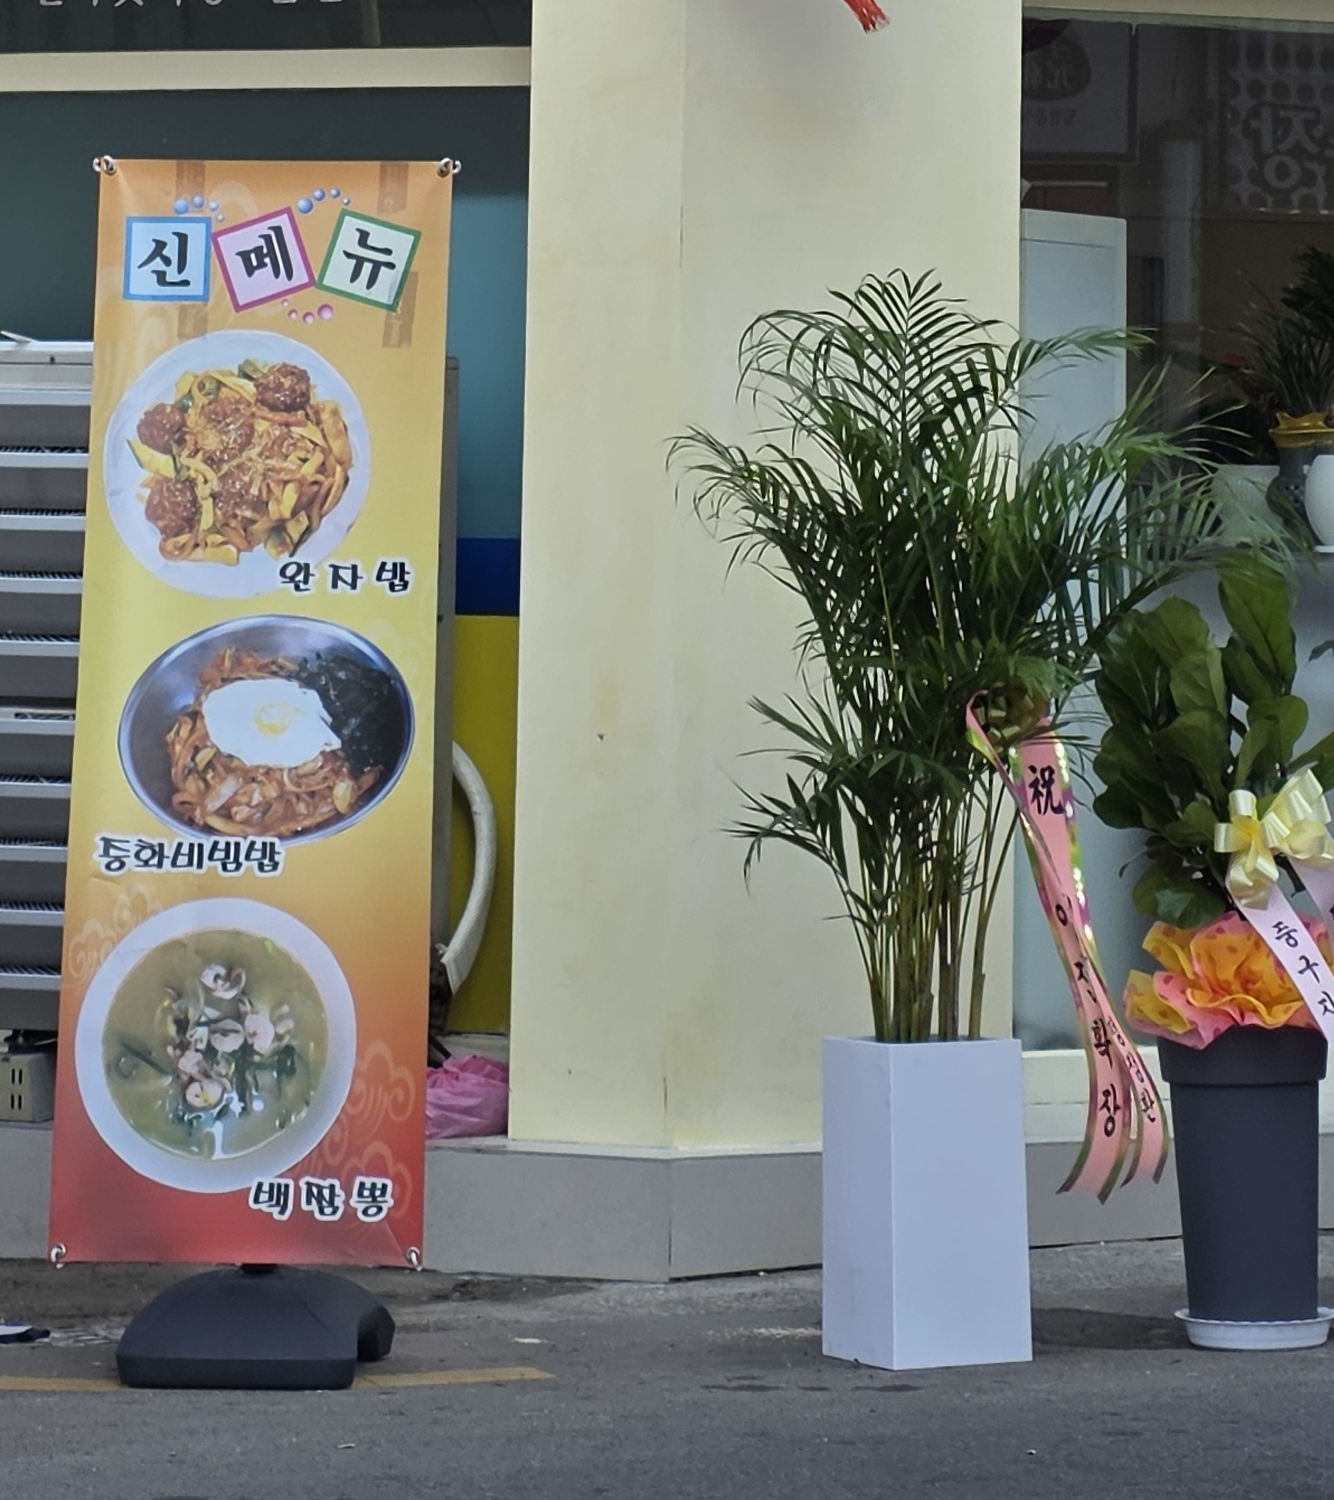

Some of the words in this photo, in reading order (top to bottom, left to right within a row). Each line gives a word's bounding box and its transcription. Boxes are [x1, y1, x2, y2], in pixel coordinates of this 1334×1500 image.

[136, 224, 396, 290] 신메뉴
[278, 560, 412, 594] 완자밥
[1027, 765, 1065, 815] 祝
[98, 836, 282, 873] 중화비빔밥
